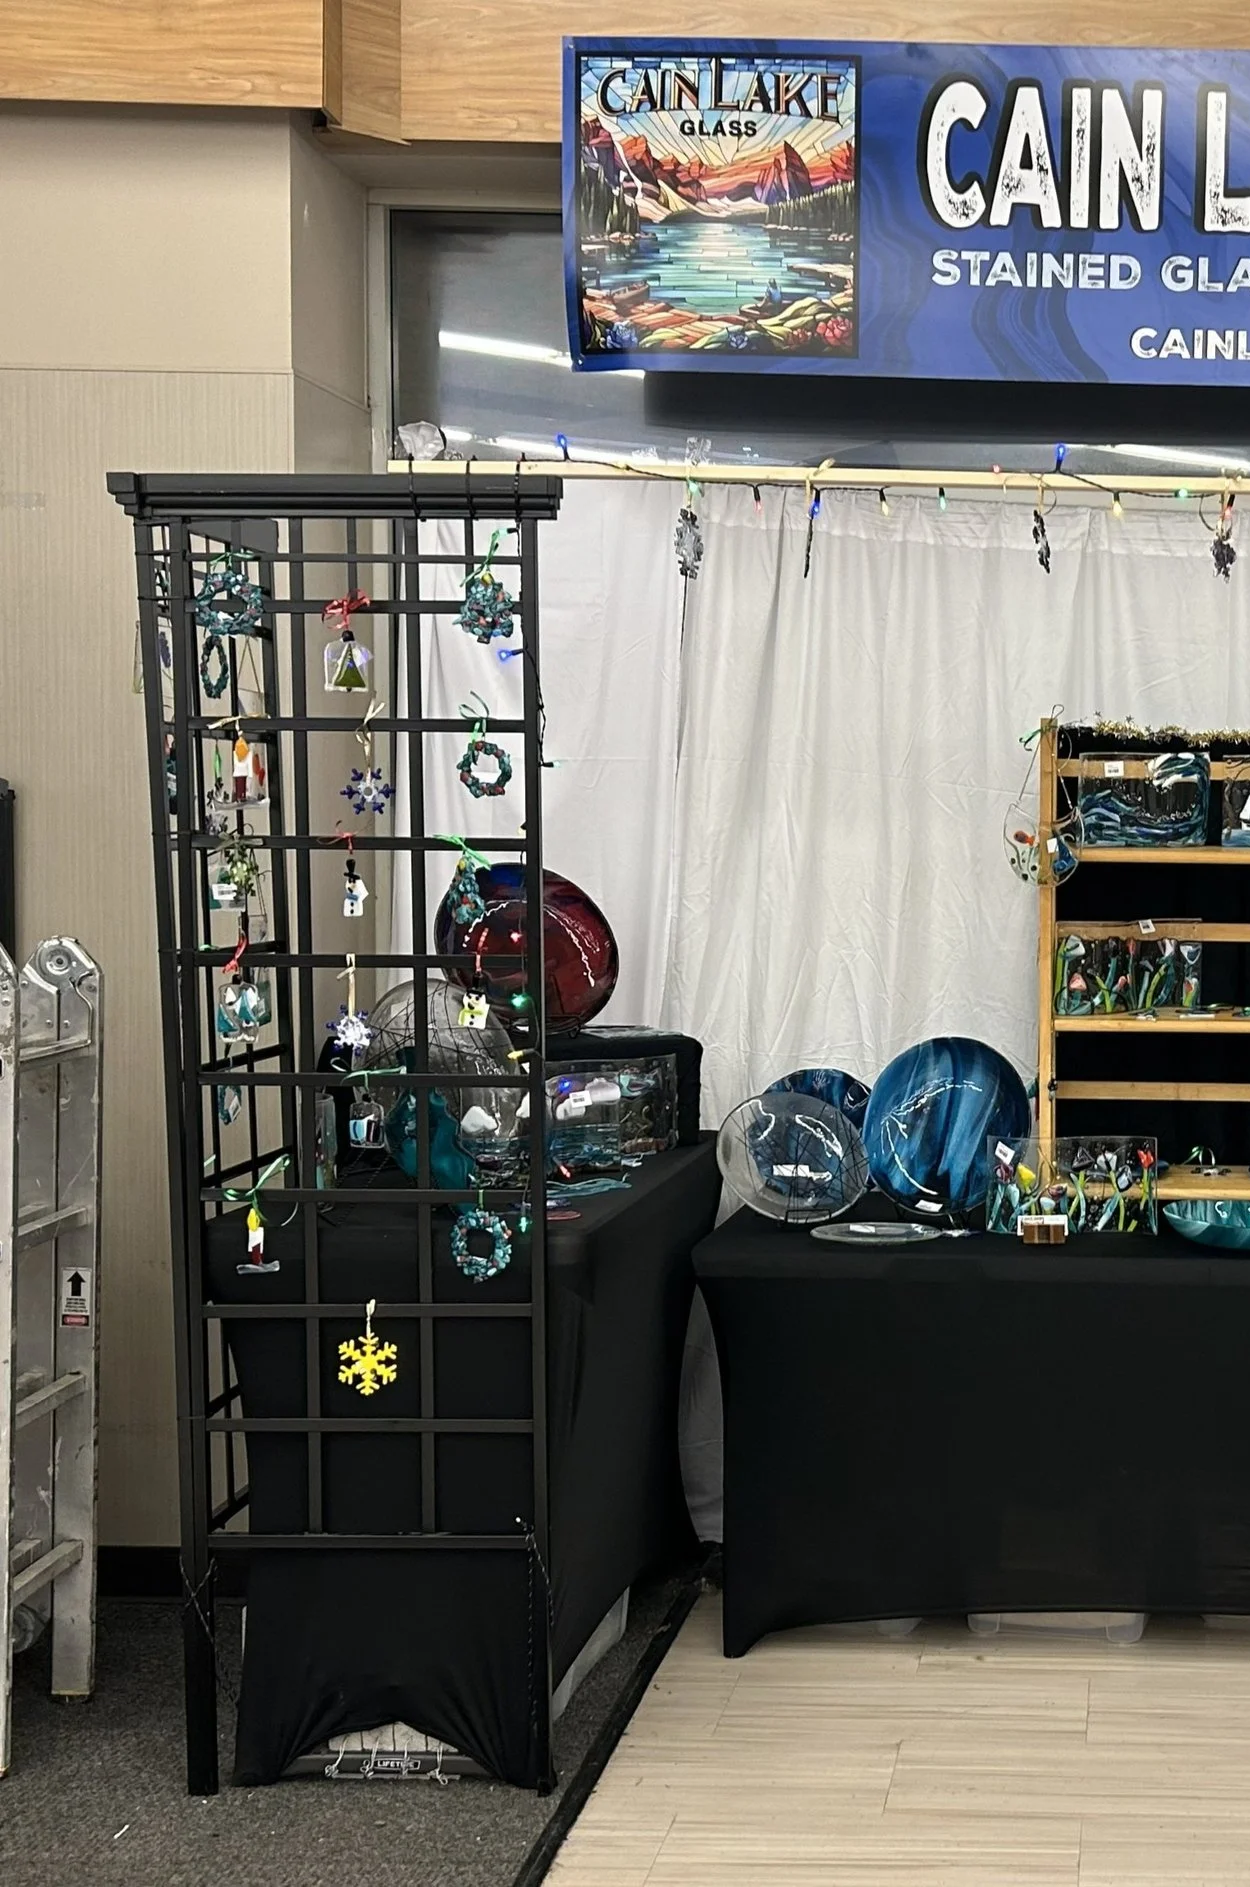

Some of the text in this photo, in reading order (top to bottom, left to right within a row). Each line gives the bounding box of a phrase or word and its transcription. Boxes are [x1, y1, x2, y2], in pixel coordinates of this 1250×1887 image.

[597, 58, 843, 123] CAIN LAKE
[680, 119, 757, 137] GLASS
[926, 80, 1163, 231] CAIN
[931, 249, 1142, 290] STAINED
